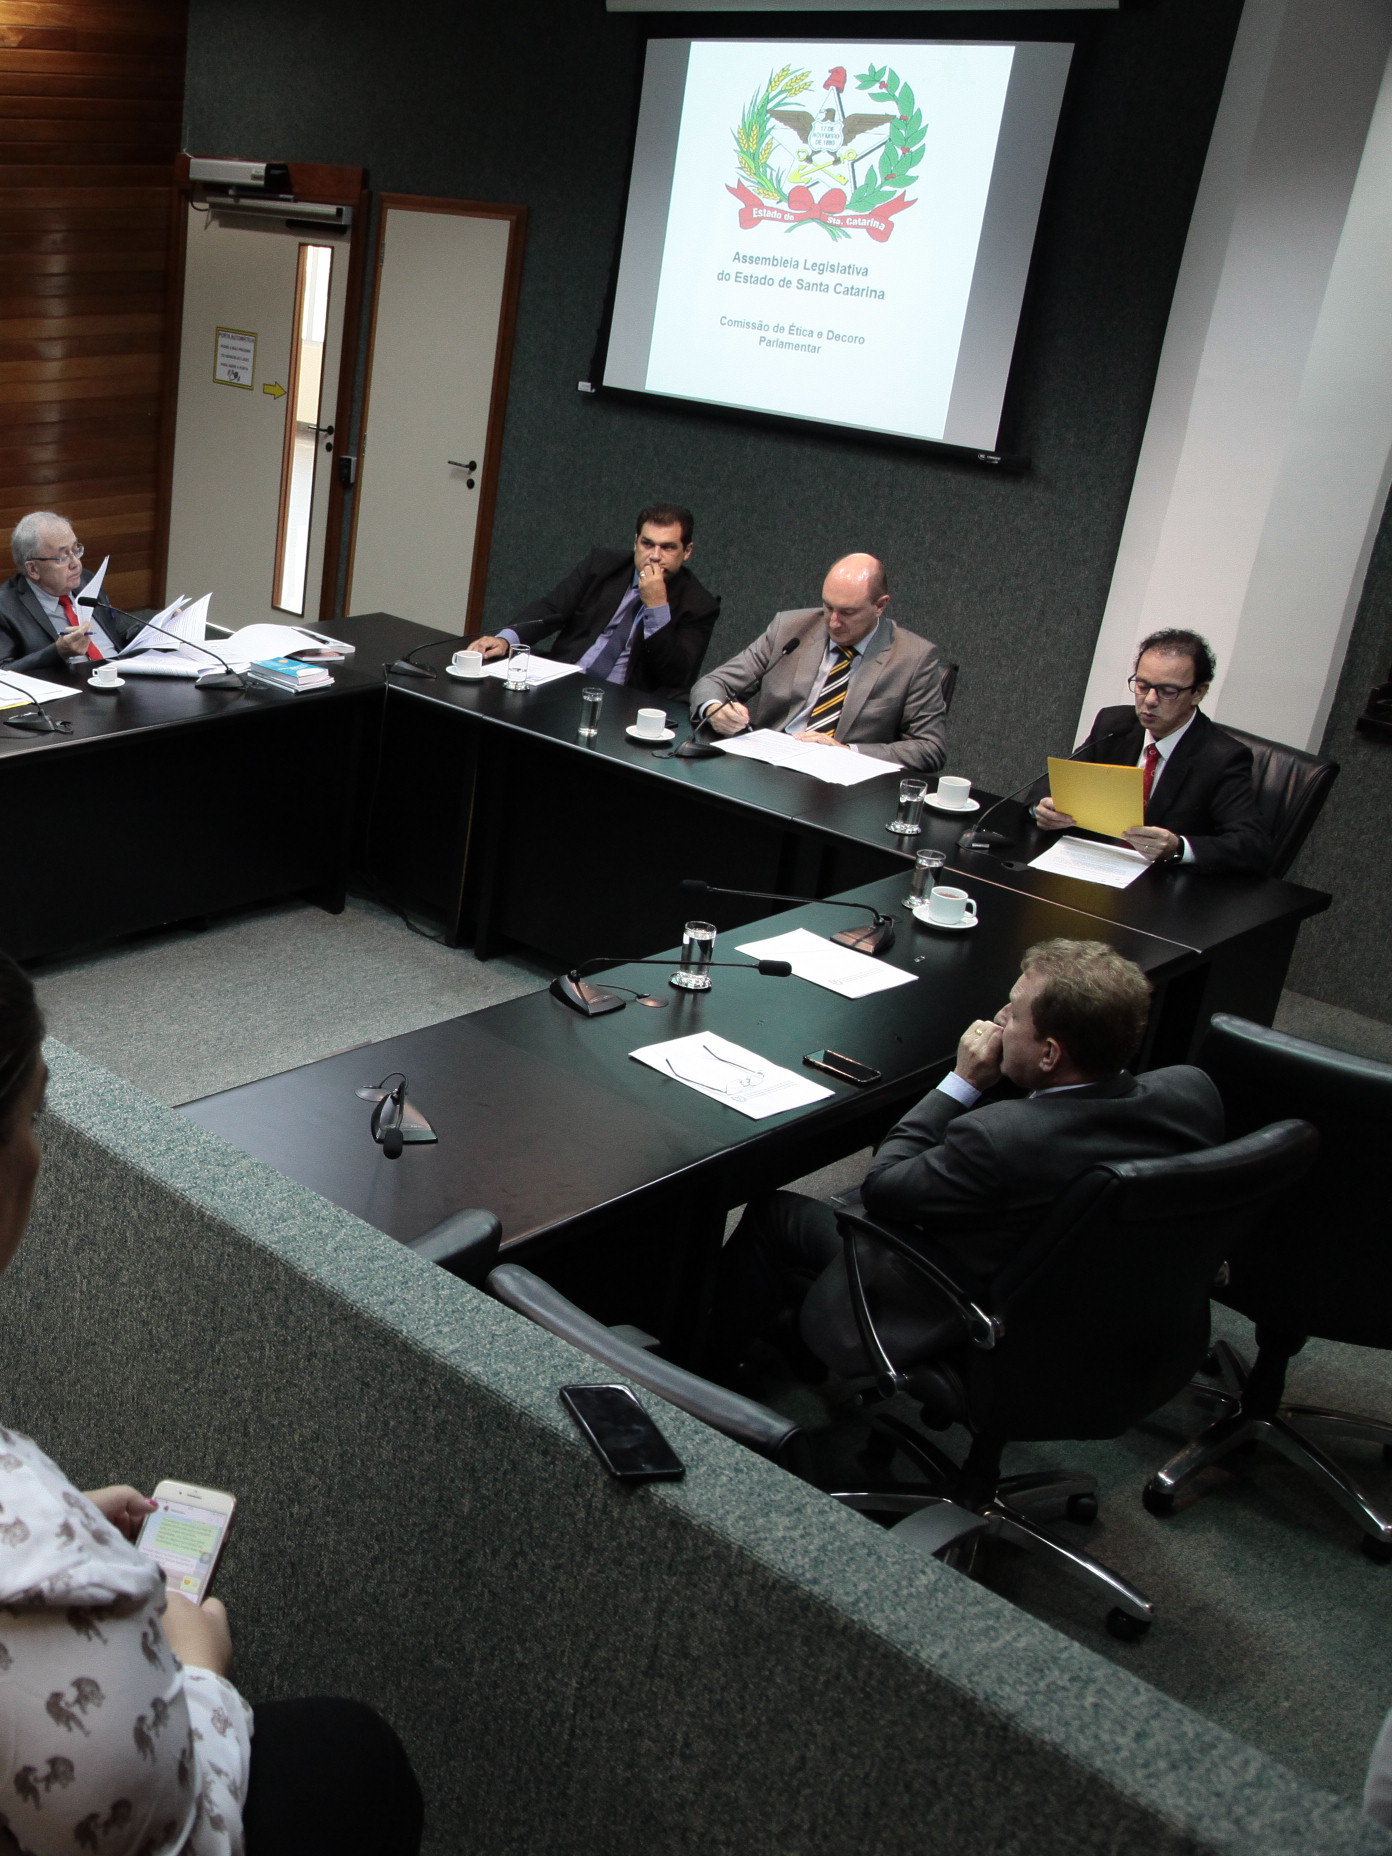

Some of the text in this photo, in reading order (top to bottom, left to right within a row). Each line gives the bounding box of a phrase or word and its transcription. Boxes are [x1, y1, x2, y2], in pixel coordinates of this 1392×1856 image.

[752, 207, 782, 219] Estado
[826, 216, 886, 231] Sta. Catarina
[732, 251, 869, 277] Assembleia Legislativa
[717, 270, 885, 300] do Estado de Santa Catarina
[719, 316, 866, 345] Comissão de Ética e Decoro
[758, 336, 822, 354] Parlamentar
